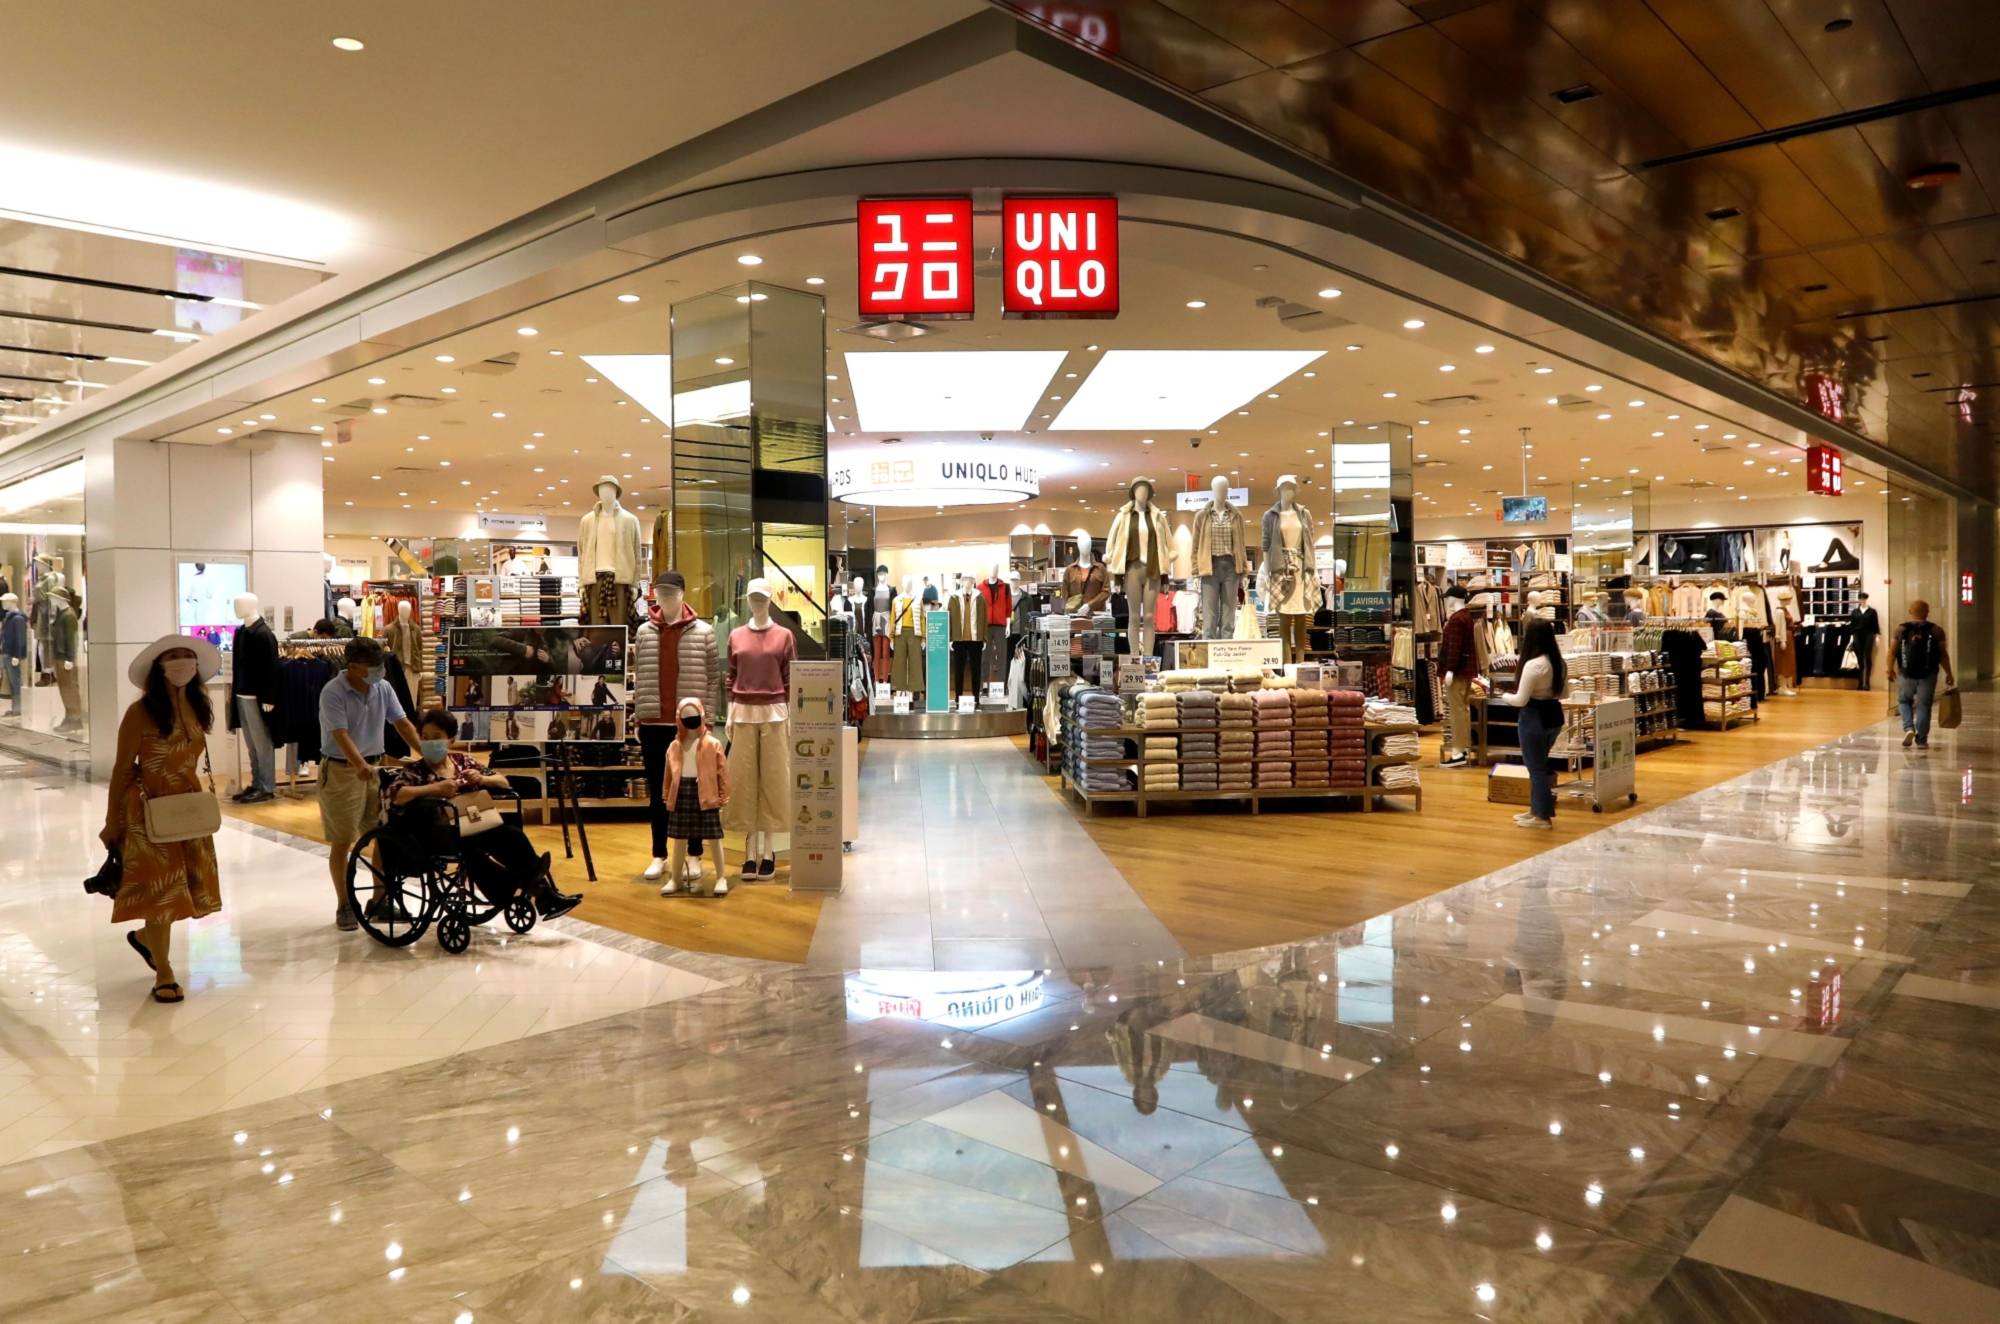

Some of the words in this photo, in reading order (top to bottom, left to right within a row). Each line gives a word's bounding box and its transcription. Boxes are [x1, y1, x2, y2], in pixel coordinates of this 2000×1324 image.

[873, 213, 957, 252] ユニ
[1015, 212, 1096, 251] UNI
[871, 262, 958, 300] クロ
[1016, 259, 1106, 305] QLO
[942, 462, 1008, 482] UNIQLO
